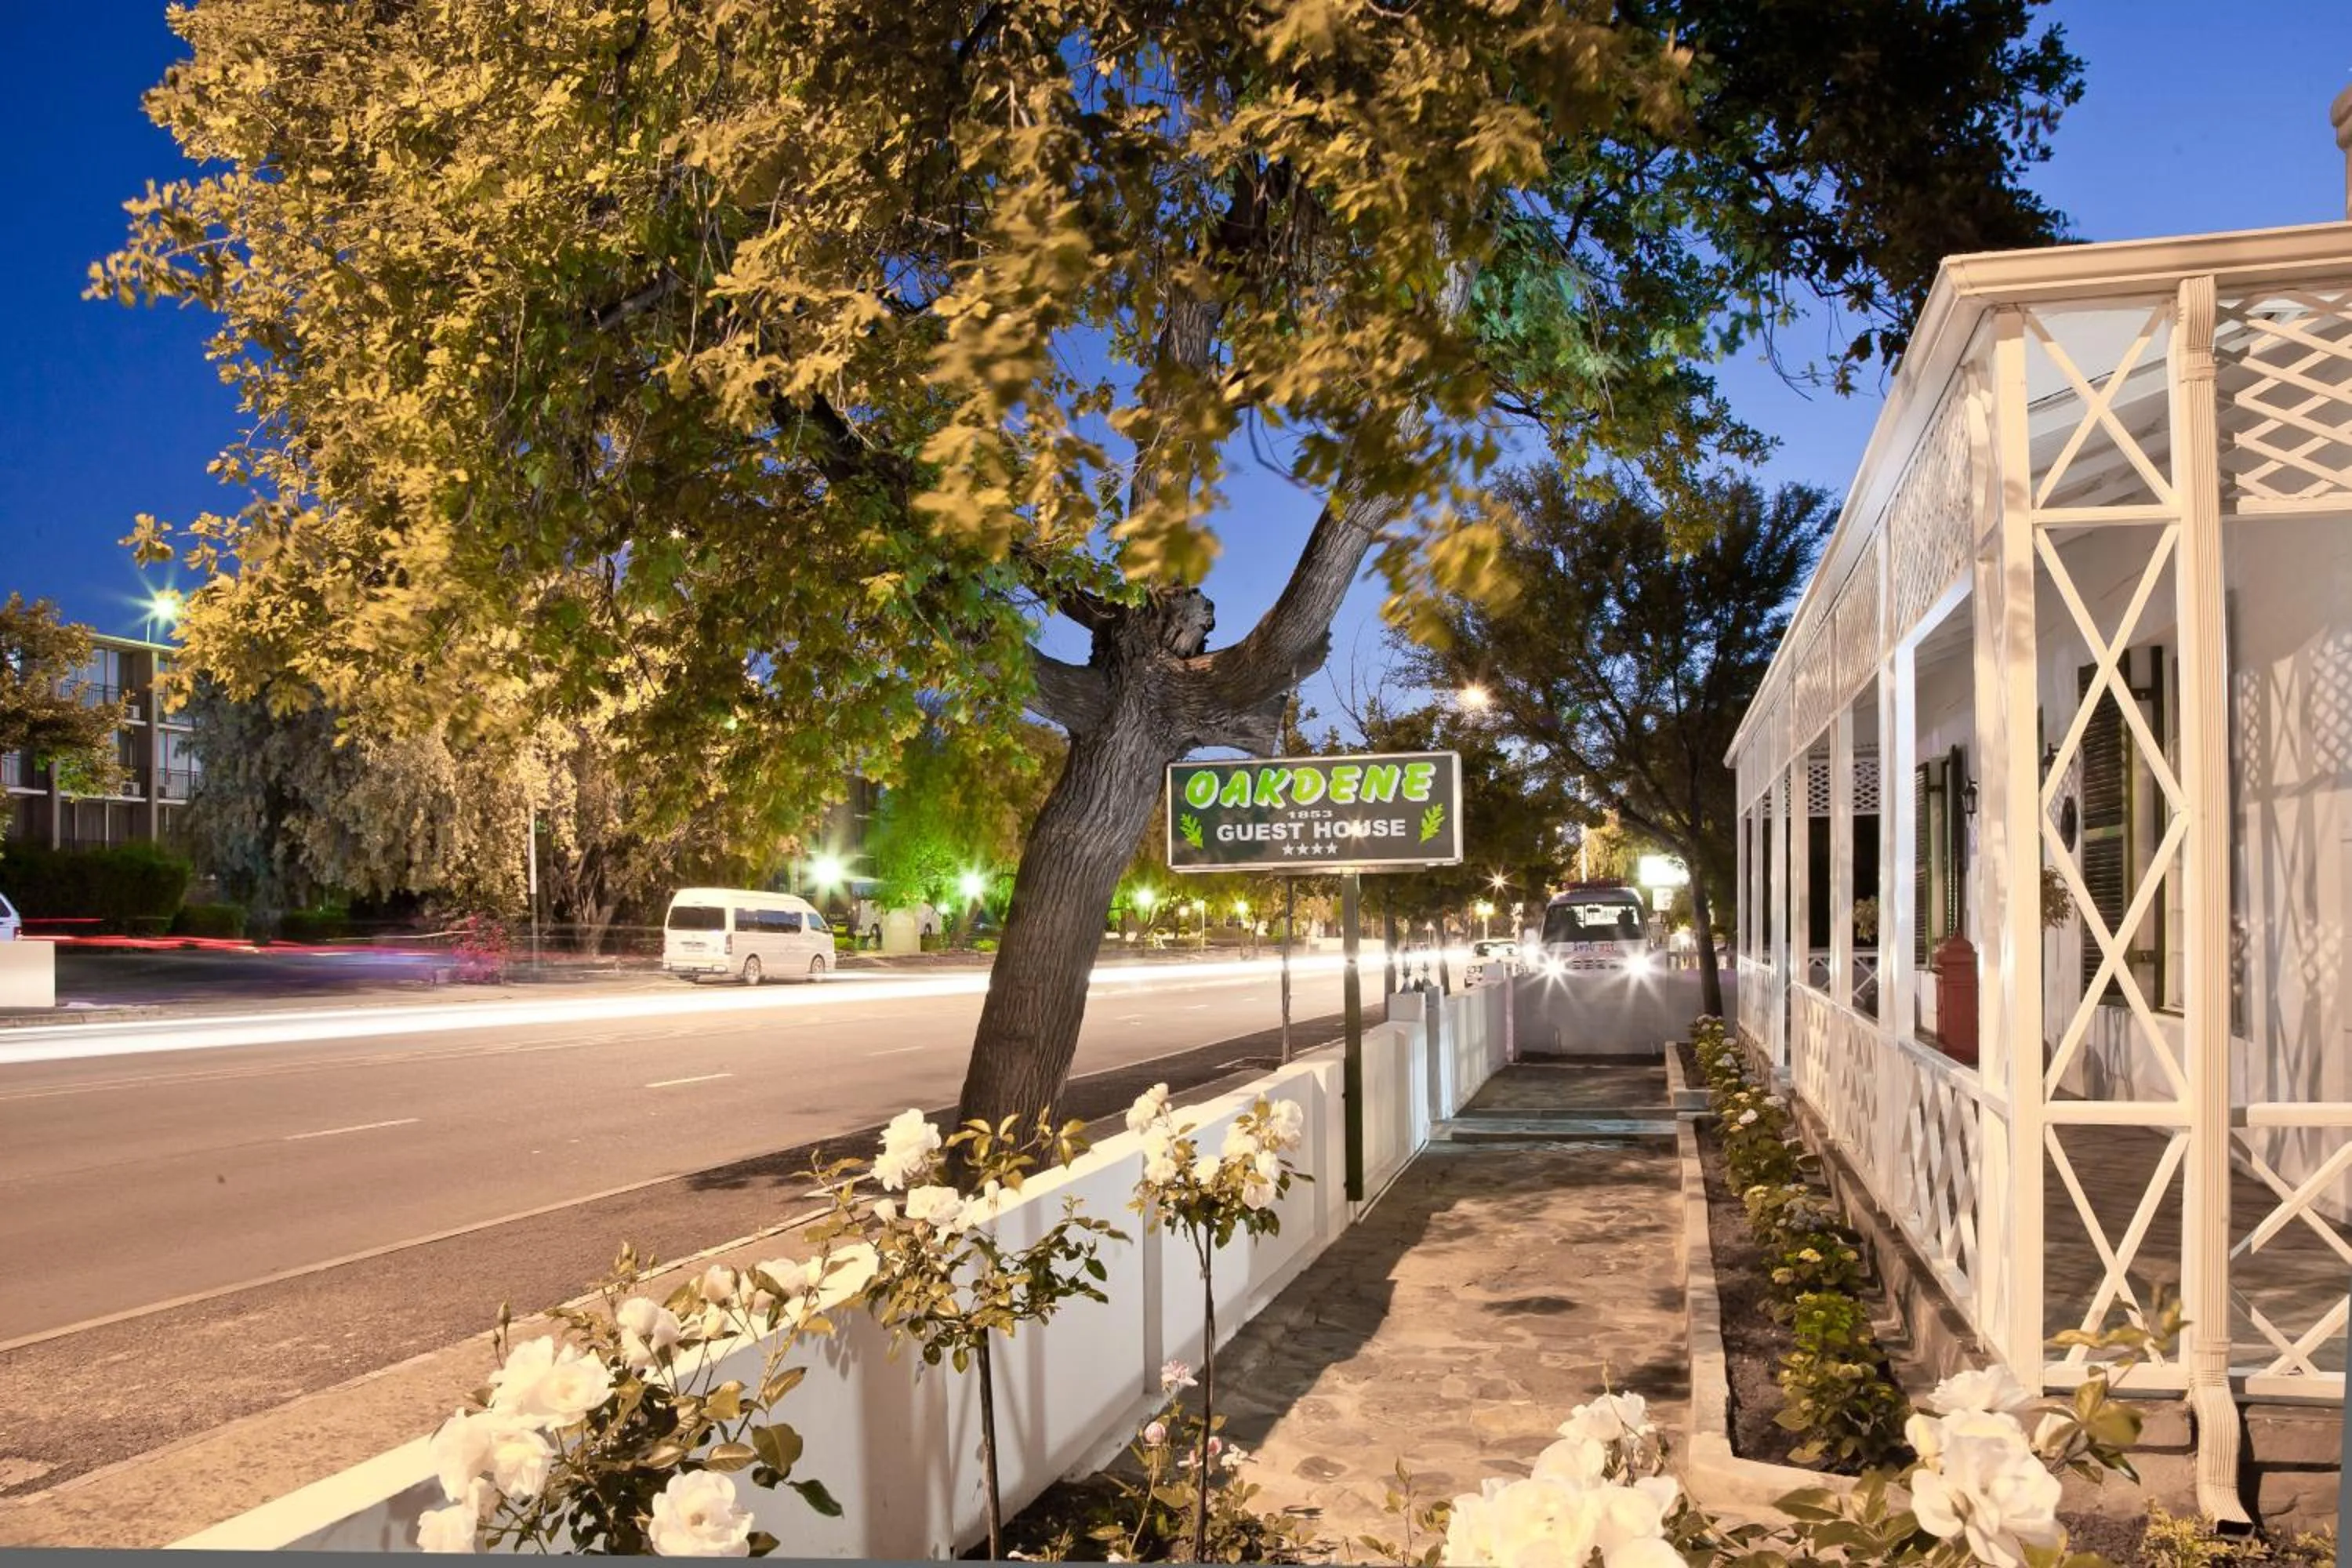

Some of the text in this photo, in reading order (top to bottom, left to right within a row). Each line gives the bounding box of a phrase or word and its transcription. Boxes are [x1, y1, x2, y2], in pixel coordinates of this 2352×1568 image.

[1185, 762, 1436, 809] OAKDENE
[1216, 819, 1406, 841] GUEST HOUSE
